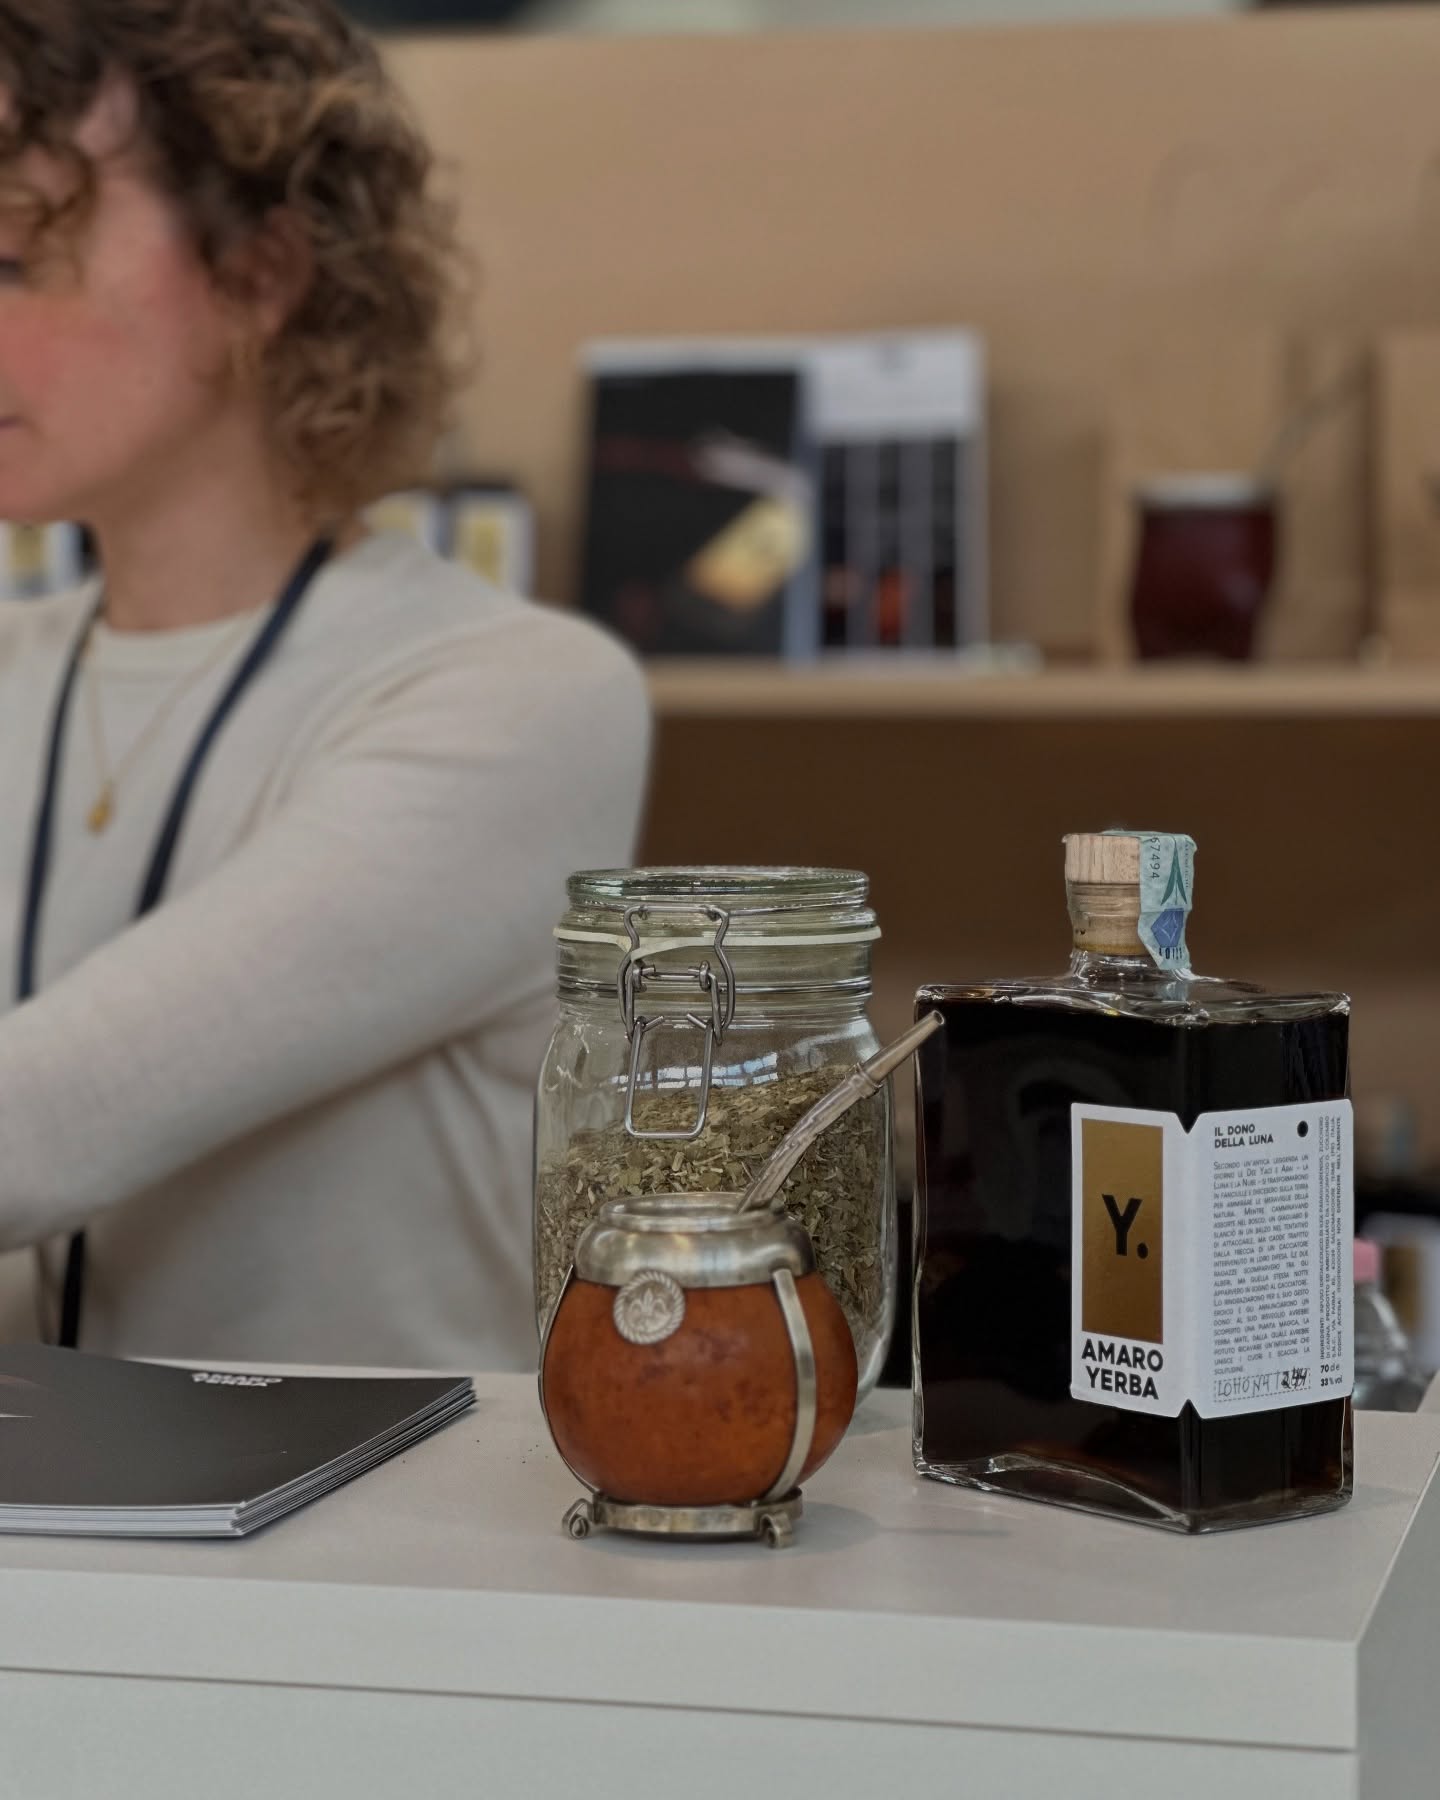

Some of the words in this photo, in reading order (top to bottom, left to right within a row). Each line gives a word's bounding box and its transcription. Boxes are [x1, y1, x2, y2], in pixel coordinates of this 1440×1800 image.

[1214, 1126, 1224, 1136] IL
[1228, 1124, 1256, 1136] DONO
[1214, 1136, 1245, 1148] DELLA
[1248, 1133, 1274, 1145] LUNA
[1102, 1194, 1148, 1259] Y.
[1082, 1338, 1164, 1372] AMARO
[1086, 1366, 1159, 1400] YERBA
